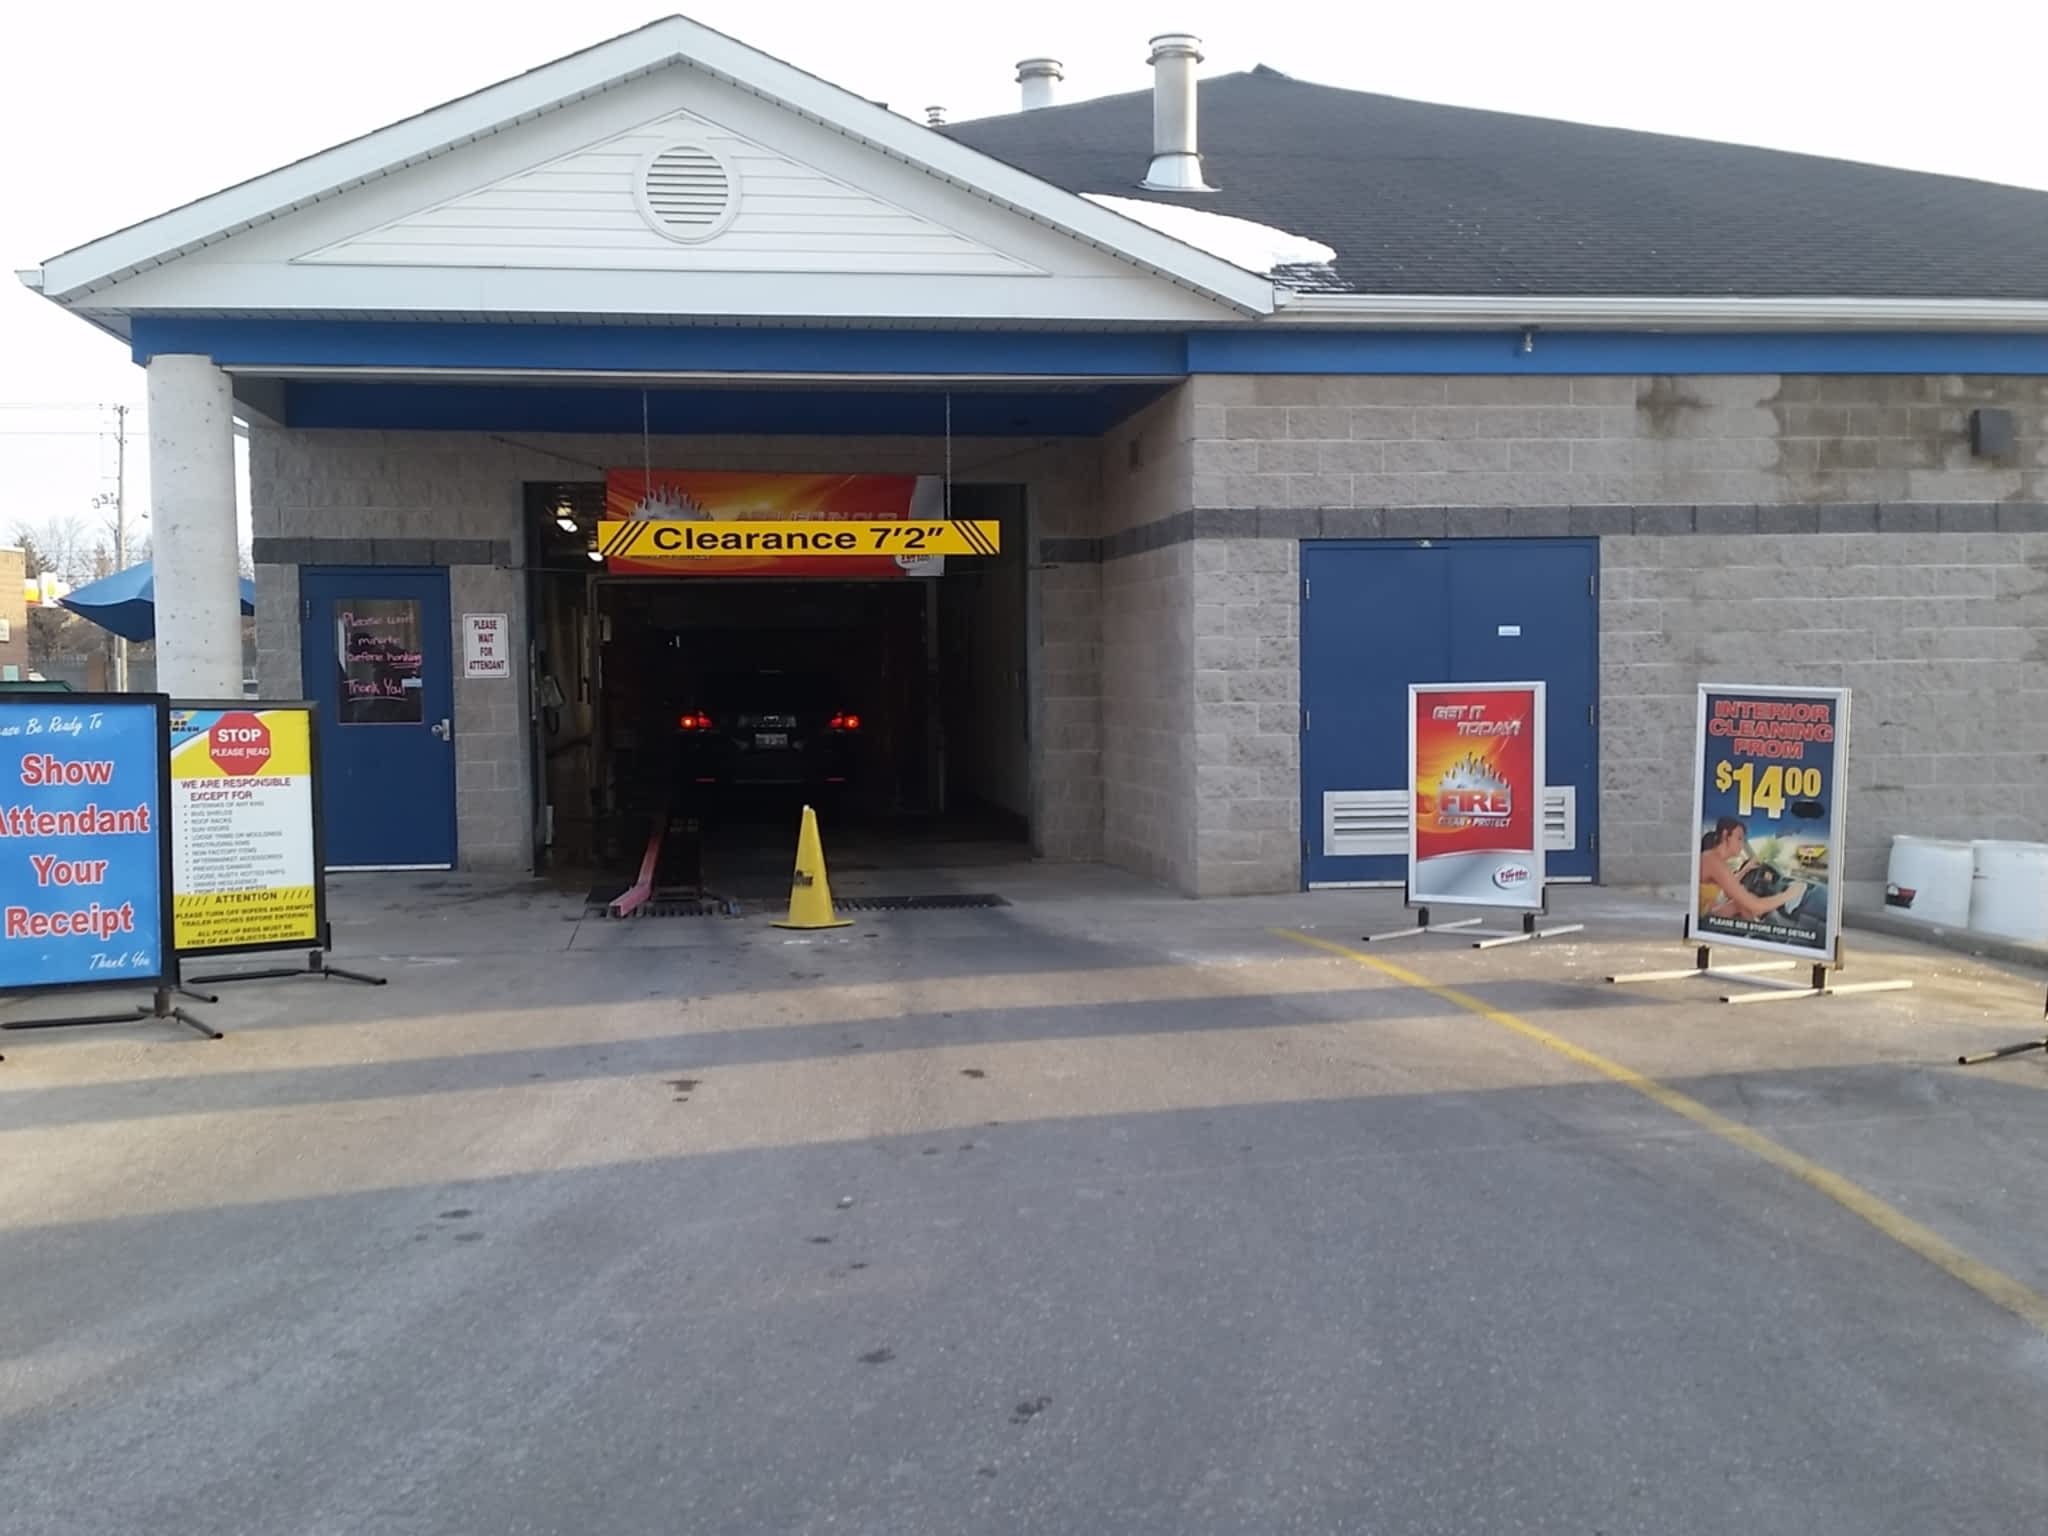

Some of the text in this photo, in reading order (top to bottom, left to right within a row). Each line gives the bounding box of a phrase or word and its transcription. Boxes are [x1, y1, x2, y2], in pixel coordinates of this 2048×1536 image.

[653, 527, 857, 550] Clearance
[343, 608, 416, 626] Please wait
[473, 619, 497, 630] PLEASE
[478, 633, 494, 644] WAIT
[479, 647, 493, 657] FOR
[469, 660, 505, 671] ATTENDANT
[344, 679, 380, 696] Thank
[1432, 705, 1486, 720] GET IT
[1715, 700, 1830, 722] INTERIOR
[25, 718, 43, 736] Be
[48, 715, 83, 736] Ready
[89, 712, 104, 731] To
[1709, 718, 1834, 742] CLEANING
[218, 729, 262, 743] STOP
[211, 747, 270, 758] PLEASE READ
[1734, 738, 1804, 759] FROM
[21, 753, 113, 786] Show
[181, 777, 291, 790] WE ARE RESPONSIBLE
[190, 791, 253, 801] EXCEPT FOR
[1440, 790, 1508, 813] FIRE
[30, 853, 109, 887] Your
[215, 892, 277, 904] ATTENTION
[176, 911, 203, 919] PLEASE
[241, 907, 267, 915] WIPERS
[285, 903, 314, 911] REMOVE
[275, 912, 308, 921] ENTERING
[4, 901, 135, 941] Receipt
[1709, 918, 1816, 940] PLEASE SEE STORE FOR DETAILS
[89, 950, 150, 970] Thank You
